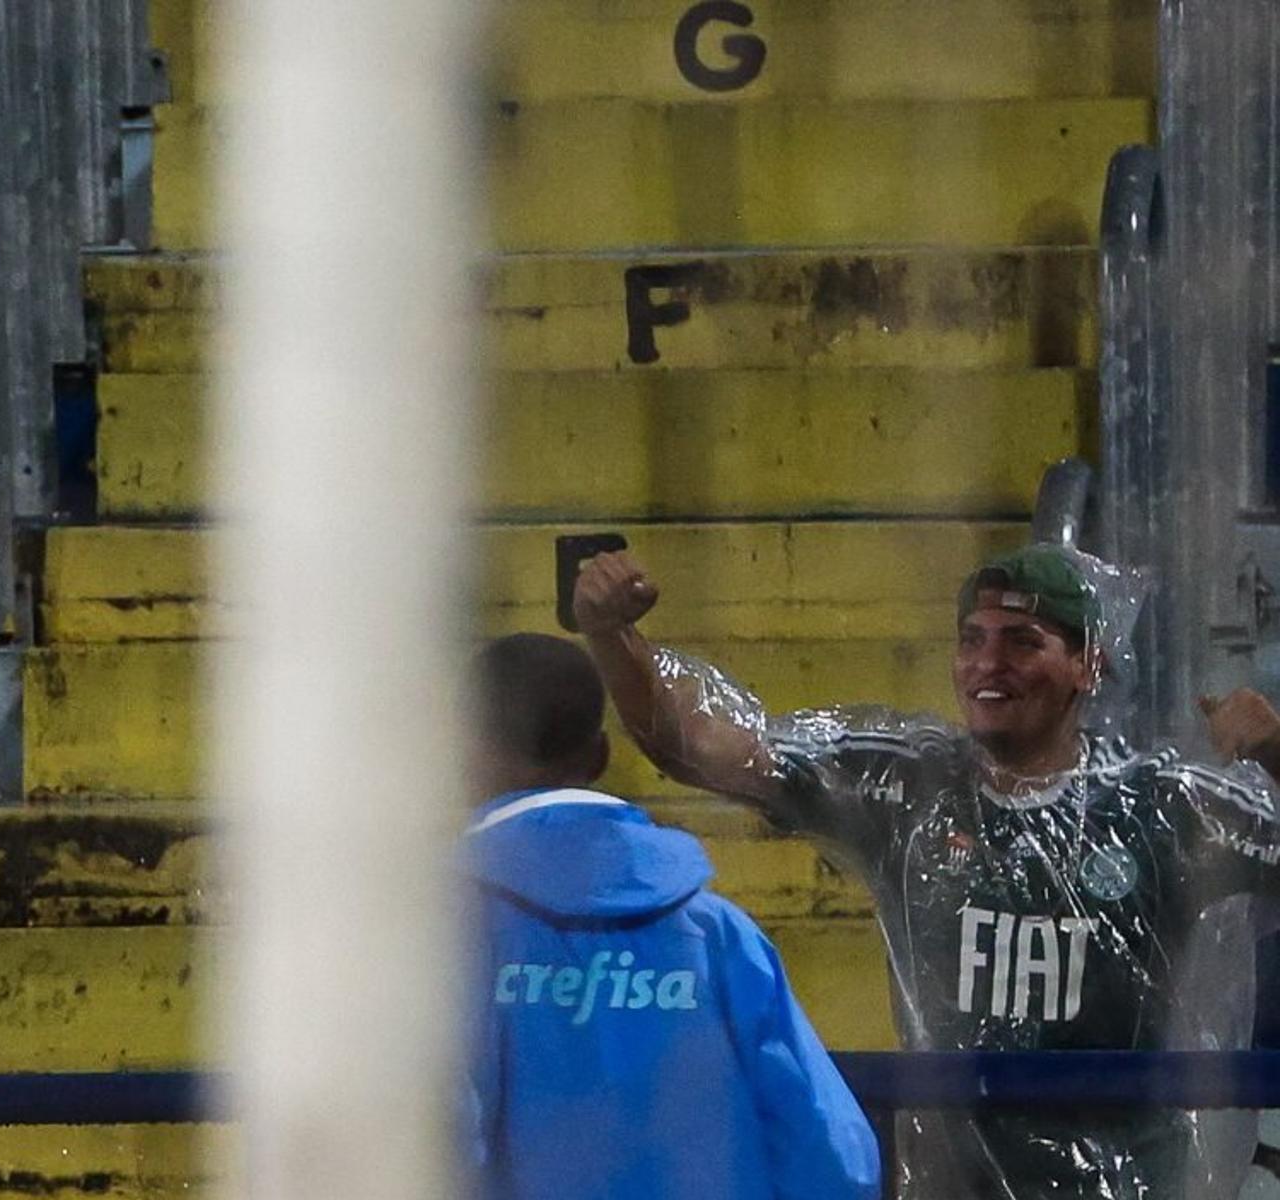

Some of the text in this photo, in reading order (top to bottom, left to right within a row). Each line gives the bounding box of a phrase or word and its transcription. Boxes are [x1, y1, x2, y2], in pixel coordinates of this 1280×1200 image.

[674, 1, 767, 92] G
[625, 263, 691, 364] F
[495, 950, 698, 1025] crefisa
[958, 905, 1100, 1021] FIAT
